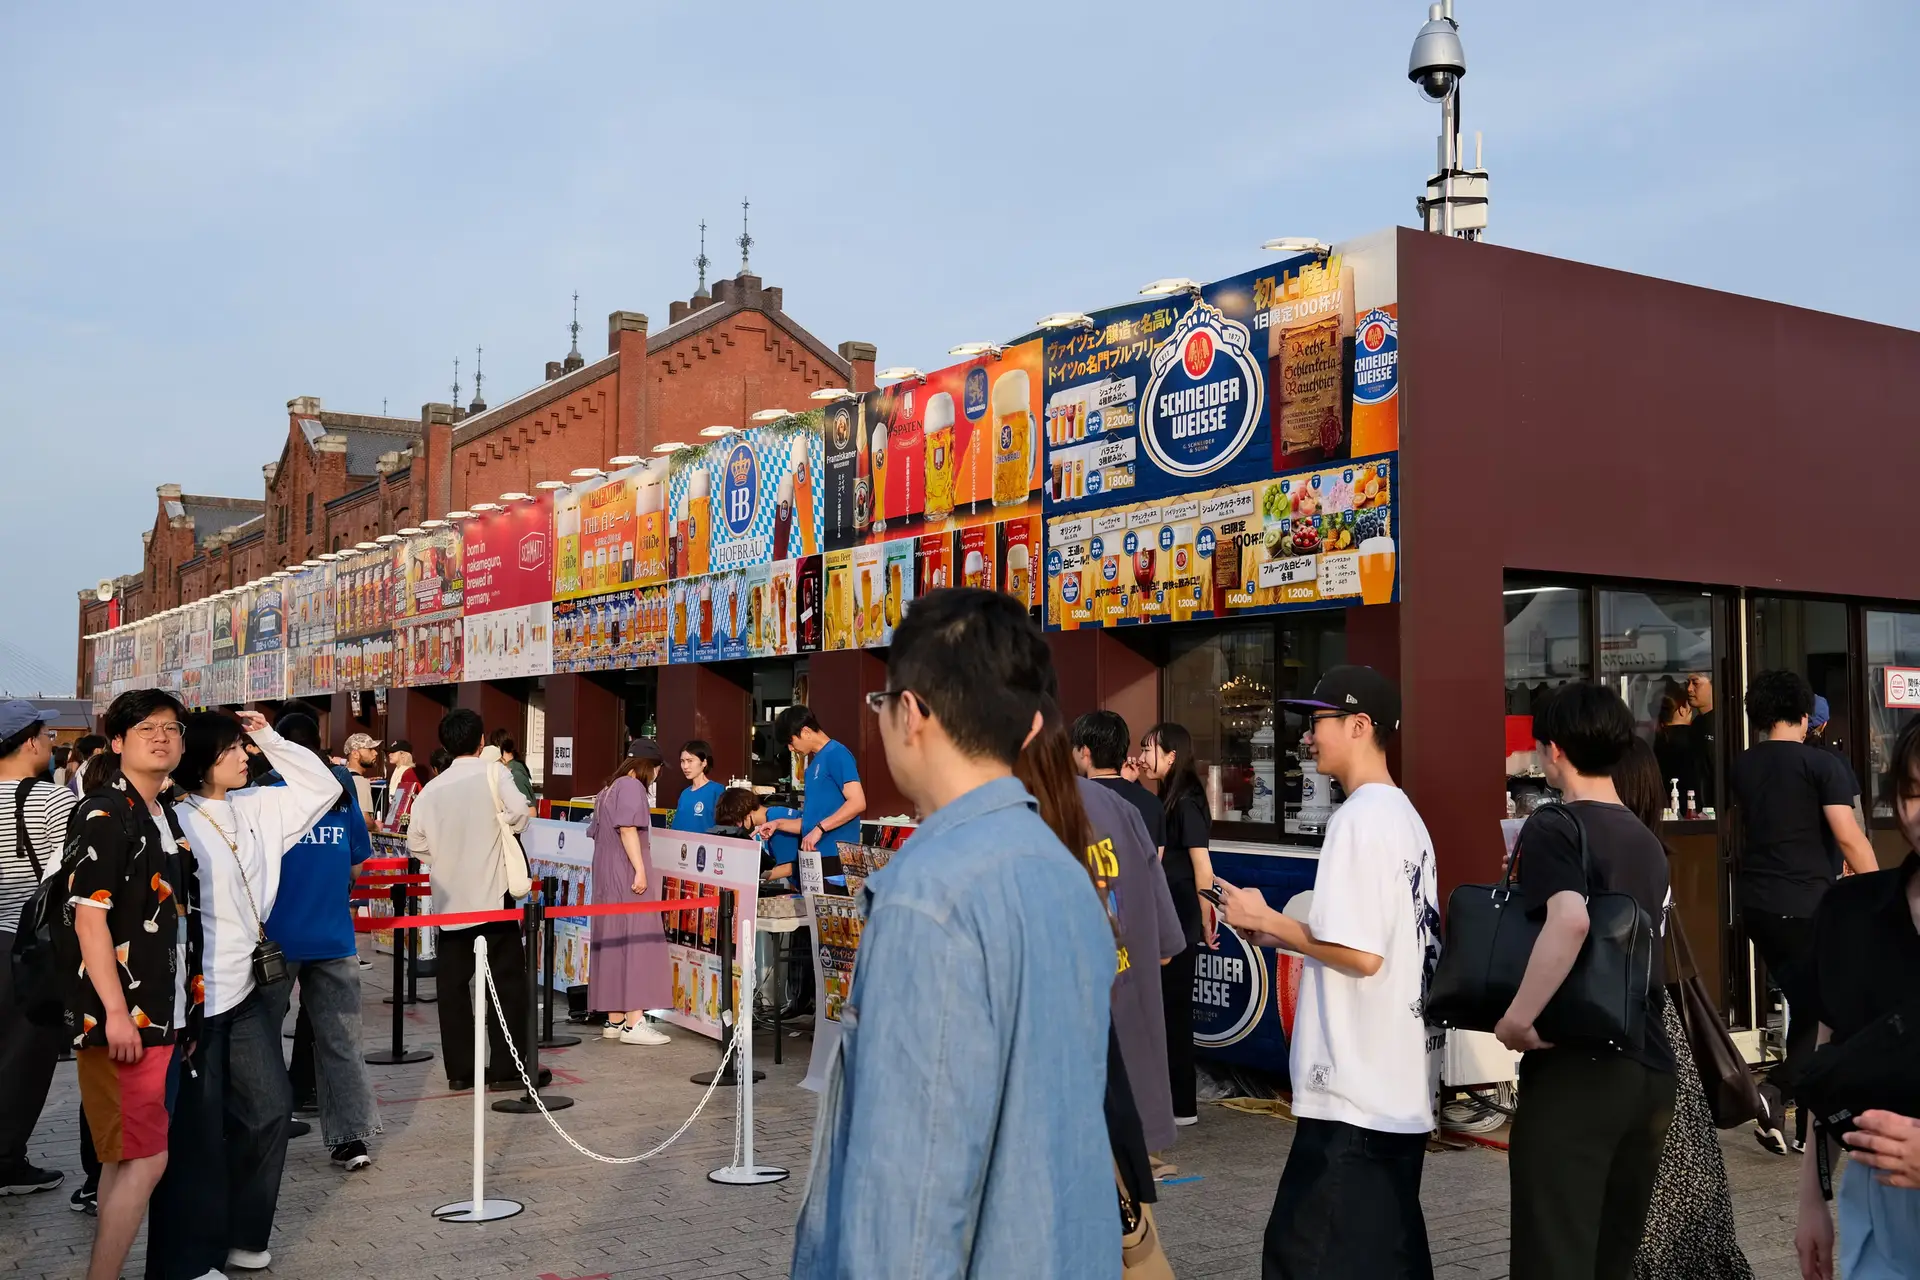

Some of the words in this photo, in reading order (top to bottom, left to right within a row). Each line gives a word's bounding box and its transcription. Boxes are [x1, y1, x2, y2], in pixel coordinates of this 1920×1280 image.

[1253, 253, 1343, 311] 初上陸!!
[1253, 291, 1342, 330] 1日限定100杯!!
[1047, 307, 1179, 361] ヴァイツェン醸造で名高い
[1228, 332, 1241, 343] 1872
[1048, 337, 1166, 385] ドイツの名門ブルワリー
[1357, 366, 1392, 386] WEISSE
[1160, 377, 1240, 418] SCHNEIDER
[894, 419, 923, 435] SPATEN
[1107, 414, 1133, 427] 2,200円
[1172, 406, 1226, 440] WEISSE
[827, 450, 856, 464] Franziskaner
[1108, 475, 1133, 487] 1,800円
[731, 487, 750, 523] HB
[584, 516, 599, 534] THE
[602, 510, 630, 531] 白ビール
[1221, 520, 1246, 535] 1日限定
[467, 542, 479, 556] born
[480, 540, 485, 552] in
[521, 540, 542, 562] SCHMATZ
[719, 539, 762, 563] HOFBRÄU
[467, 555, 501, 573] nakameguro,
[1063, 555, 1090, 569] 白ビール!!
[1263, 559, 1312, 574] フルーツ&白ビール
[467, 575, 487, 590] brewed
[487, 572, 492, 585] in
[467, 592, 490, 608] germany.
[1228, 593, 1252, 603] 1,400円
[1288, 588, 1313, 598] 1,200円
[1908, 678, 1920, 687] 関係
[1908, 689, 1920, 697] 立入
[299, 827, 344, 844] AFF
[1195, 953, 1244, 983] EIDER
[1192, 979, 1230, 1008] EISSE
